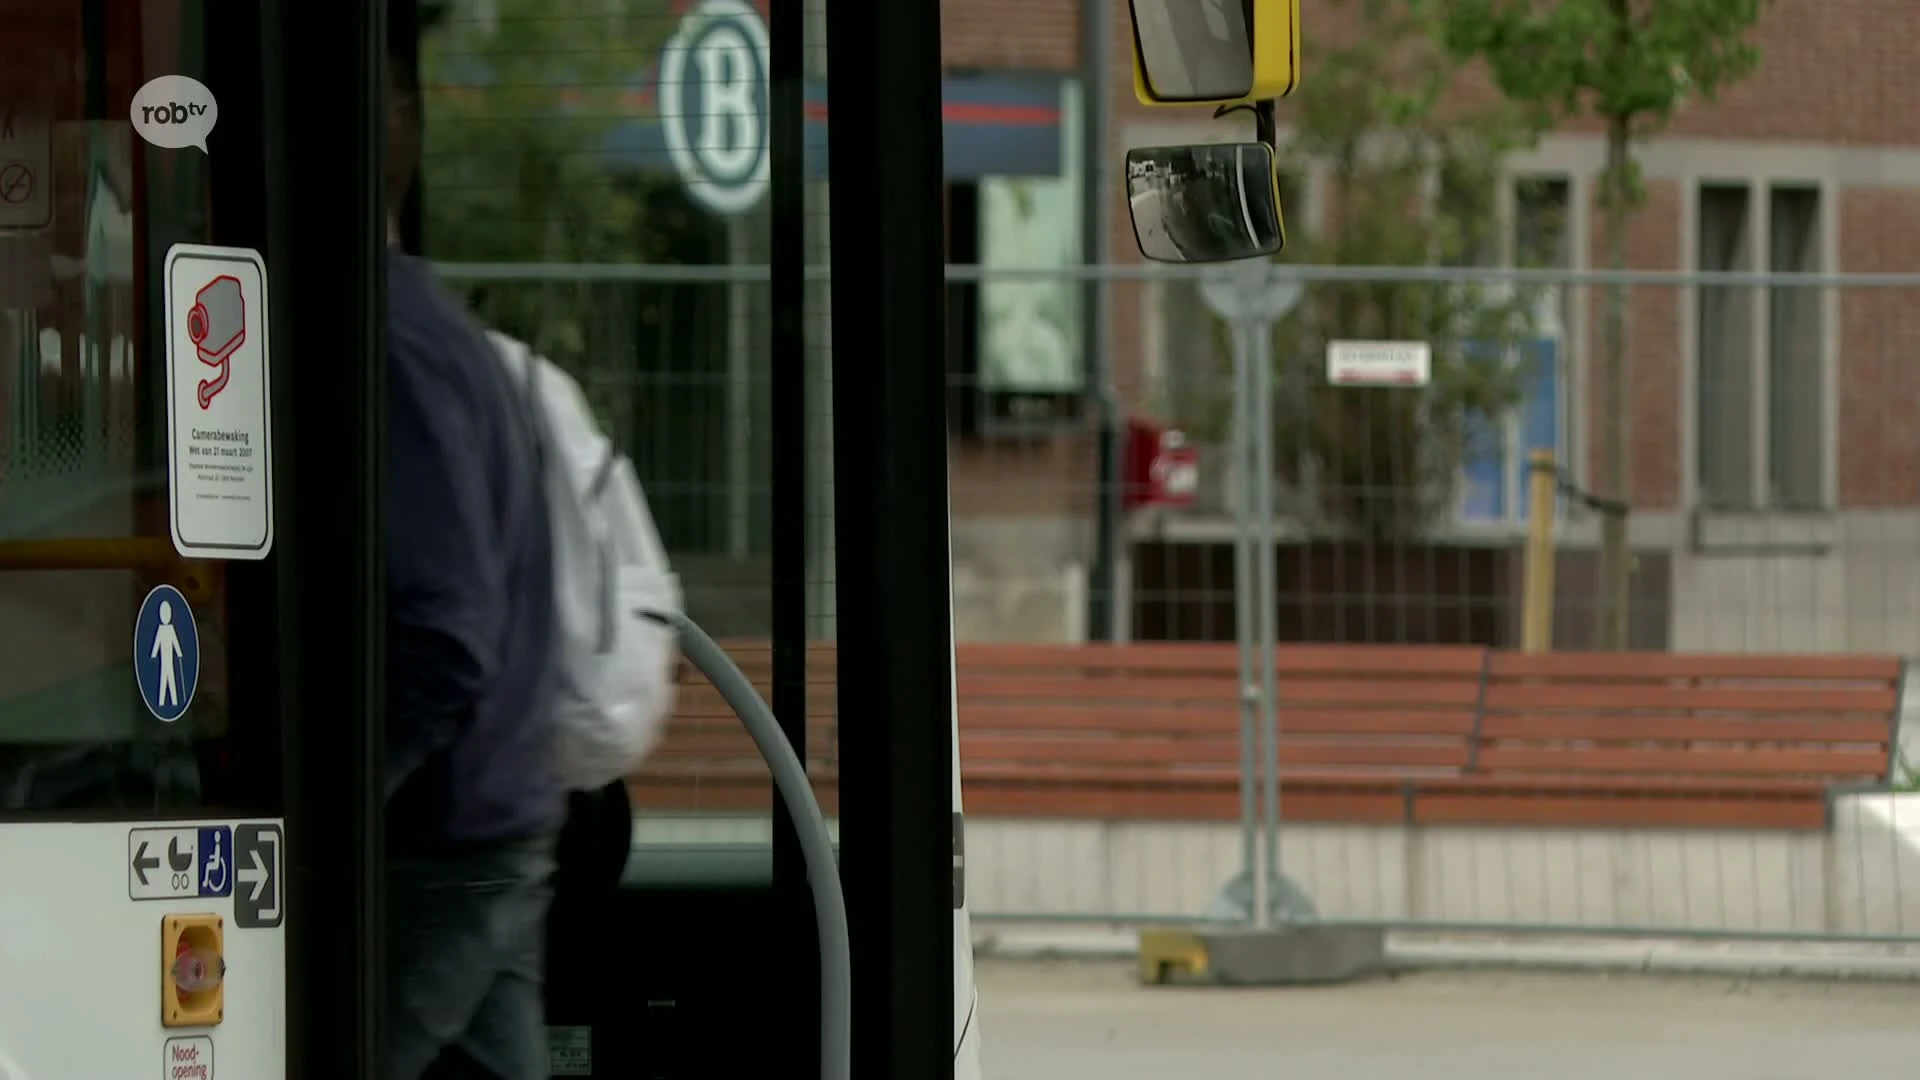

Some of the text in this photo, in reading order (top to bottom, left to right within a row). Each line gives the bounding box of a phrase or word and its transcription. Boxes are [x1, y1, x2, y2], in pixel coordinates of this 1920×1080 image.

[693, 28, 762, 174] B
[191, 427, 249, 446] Camerabewaking
[201, 447, 213, 456] van
[213, 446, 220, 456] 21
[220, 447, 238, 457] maart
[172, 1043, 200, 1062] Nood-
[172, 1062, 207, 1080] opening
